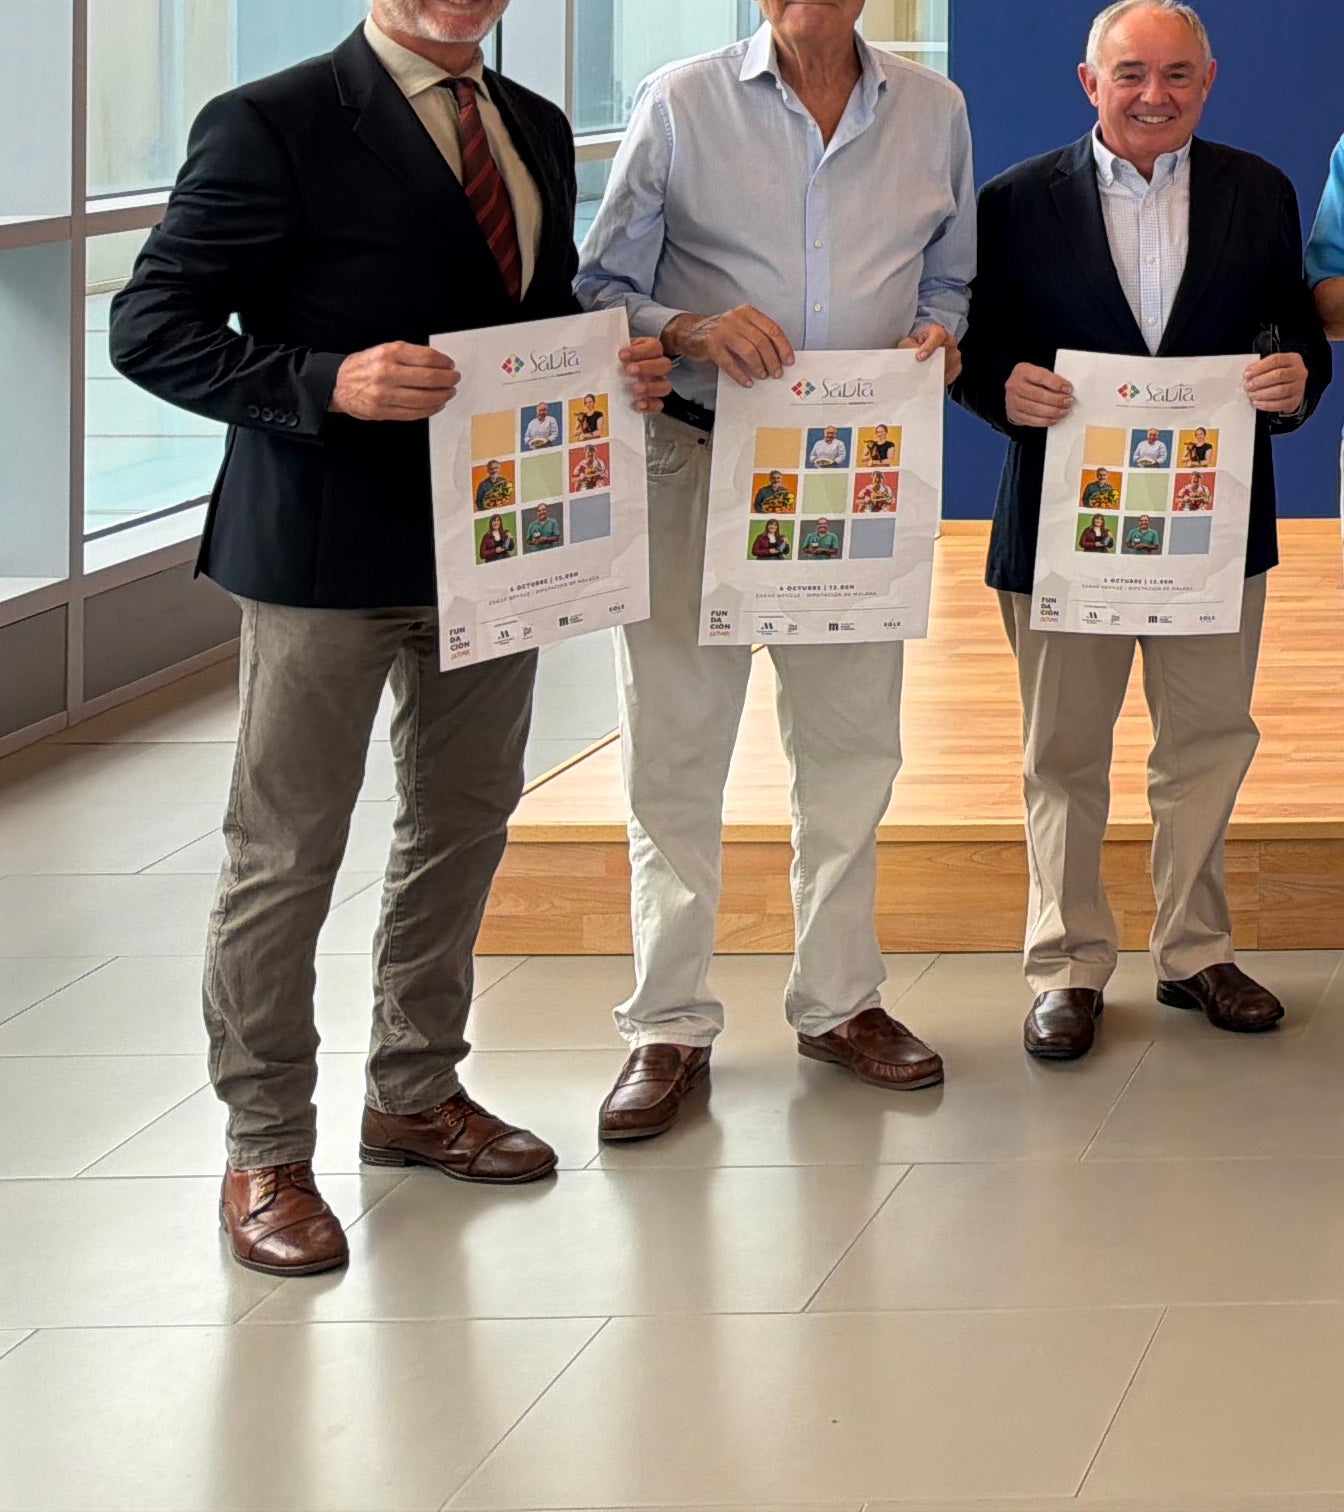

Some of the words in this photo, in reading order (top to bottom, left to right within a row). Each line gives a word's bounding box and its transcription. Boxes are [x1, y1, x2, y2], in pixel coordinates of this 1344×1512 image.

[516, 578, 547, 592] OCTUBRE
[449, 626, 465, 636] FUN
[710, 622, 730, 630] CIÓN
[450, 639, 469, 651] CIÓN
